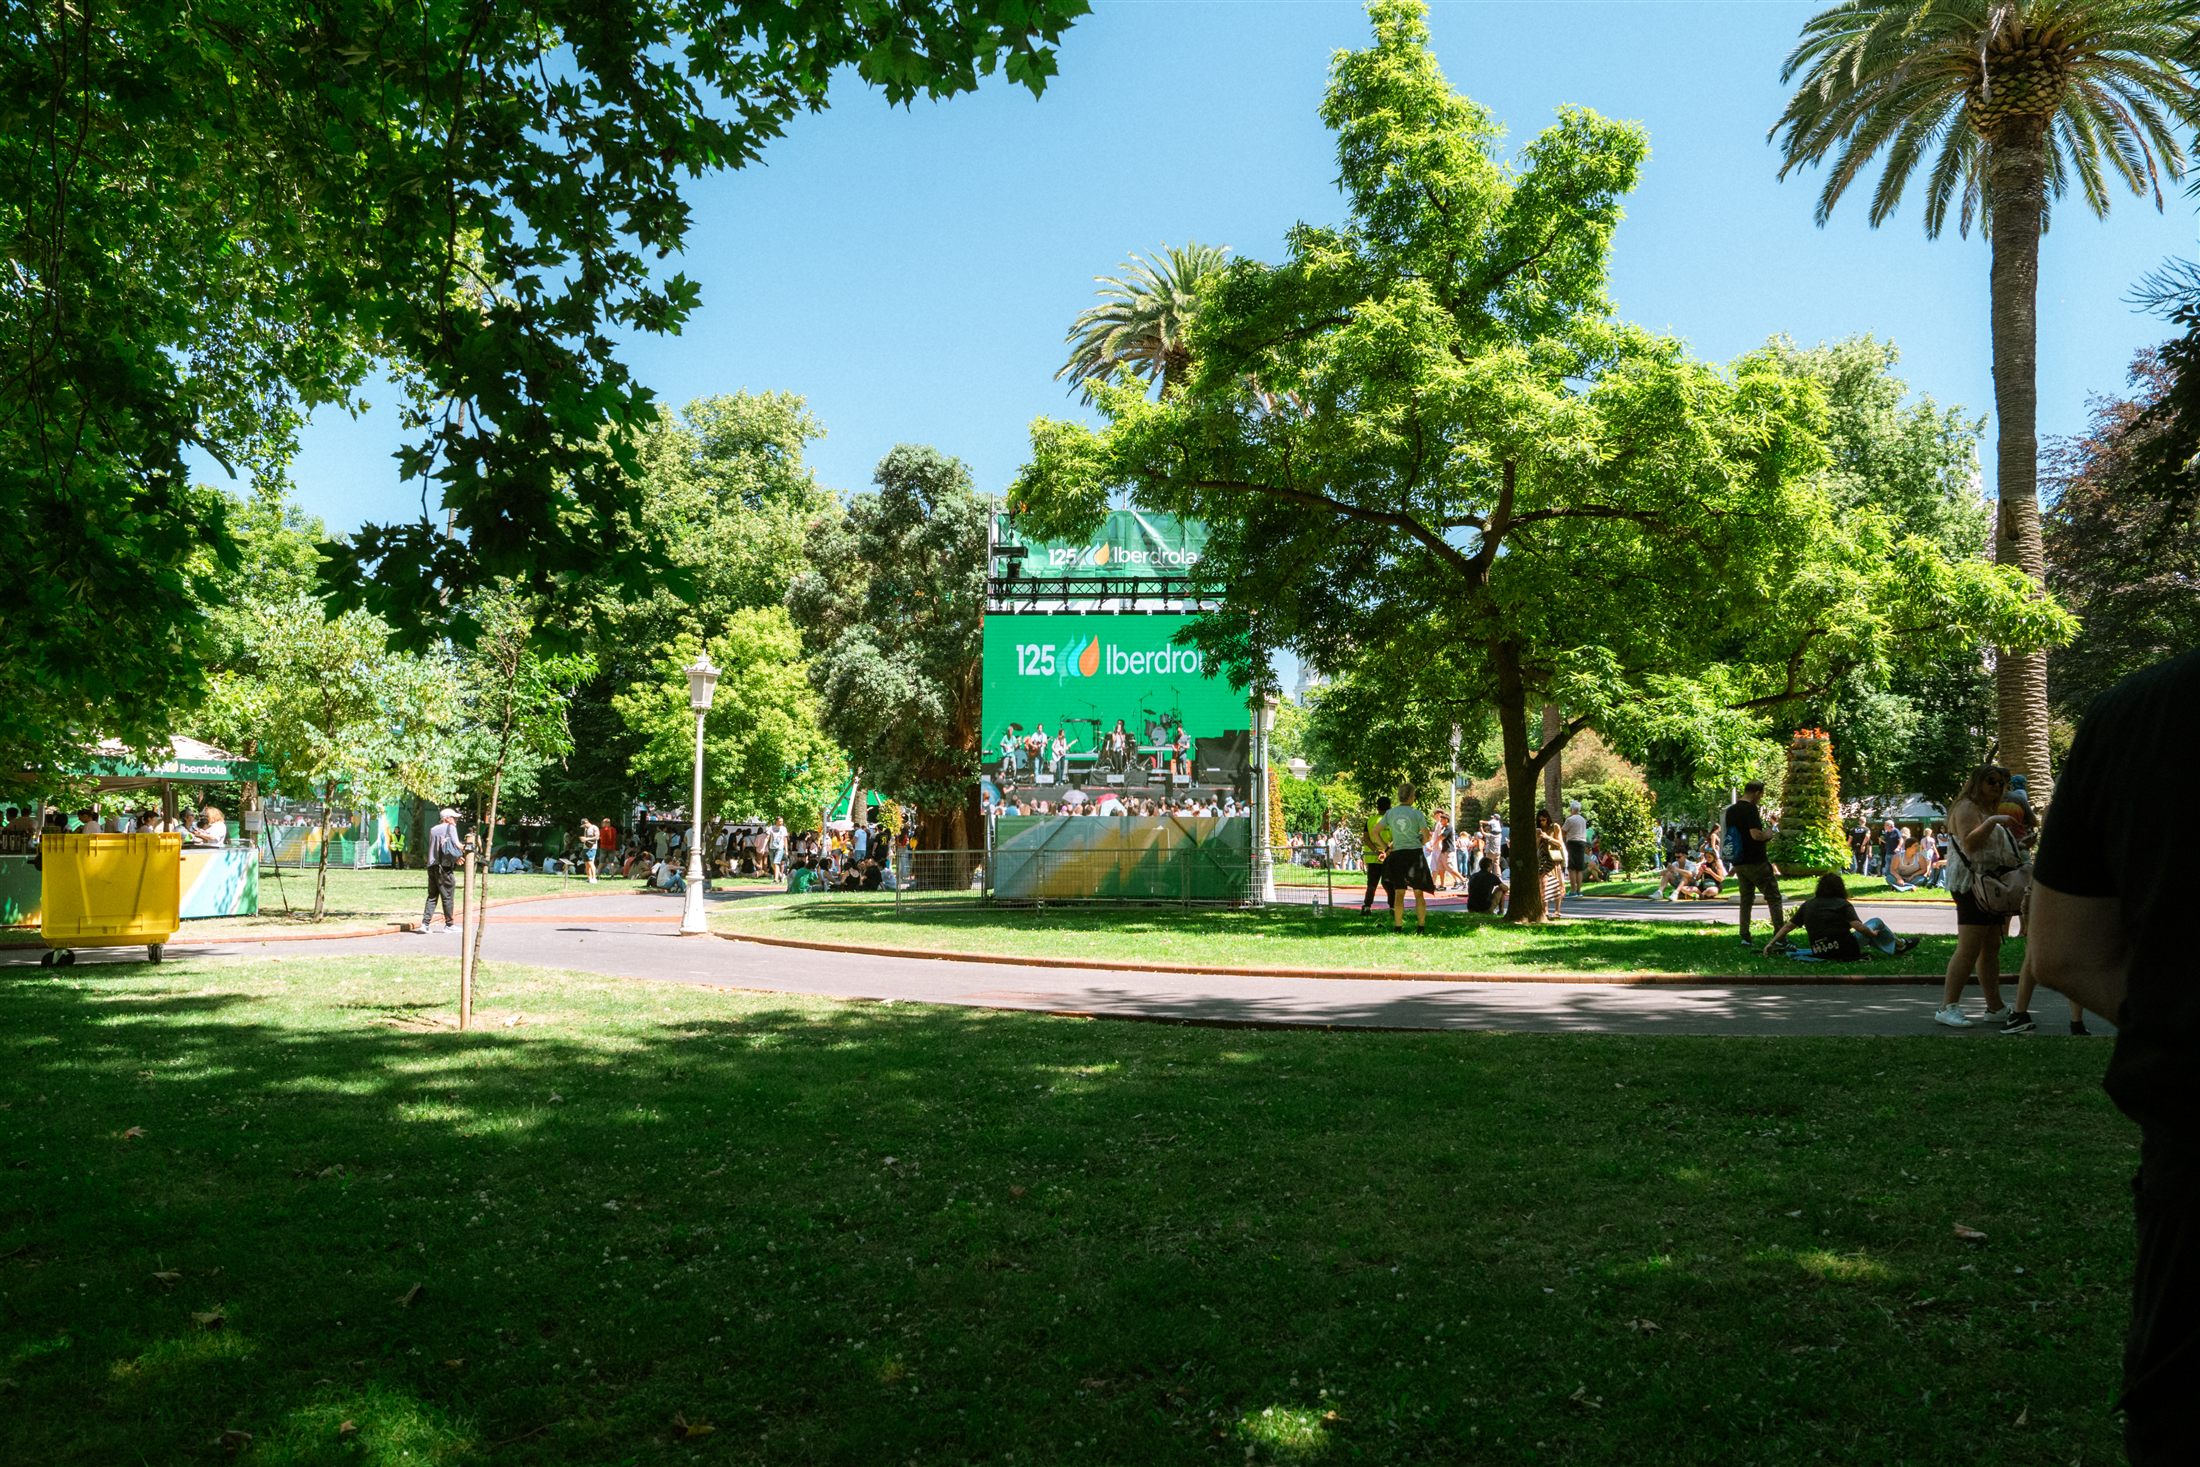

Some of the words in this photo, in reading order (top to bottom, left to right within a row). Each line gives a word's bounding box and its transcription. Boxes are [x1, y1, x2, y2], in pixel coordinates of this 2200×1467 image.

[1048, 549, 1077, 566] 125
[1113, 546, 1198, 565] Iberdrola
[1016, 644, 1056, 676] 125
[1106, 643, 1220, 676] Iberdrol
[180, 763, 227, 775] Iberdrola
